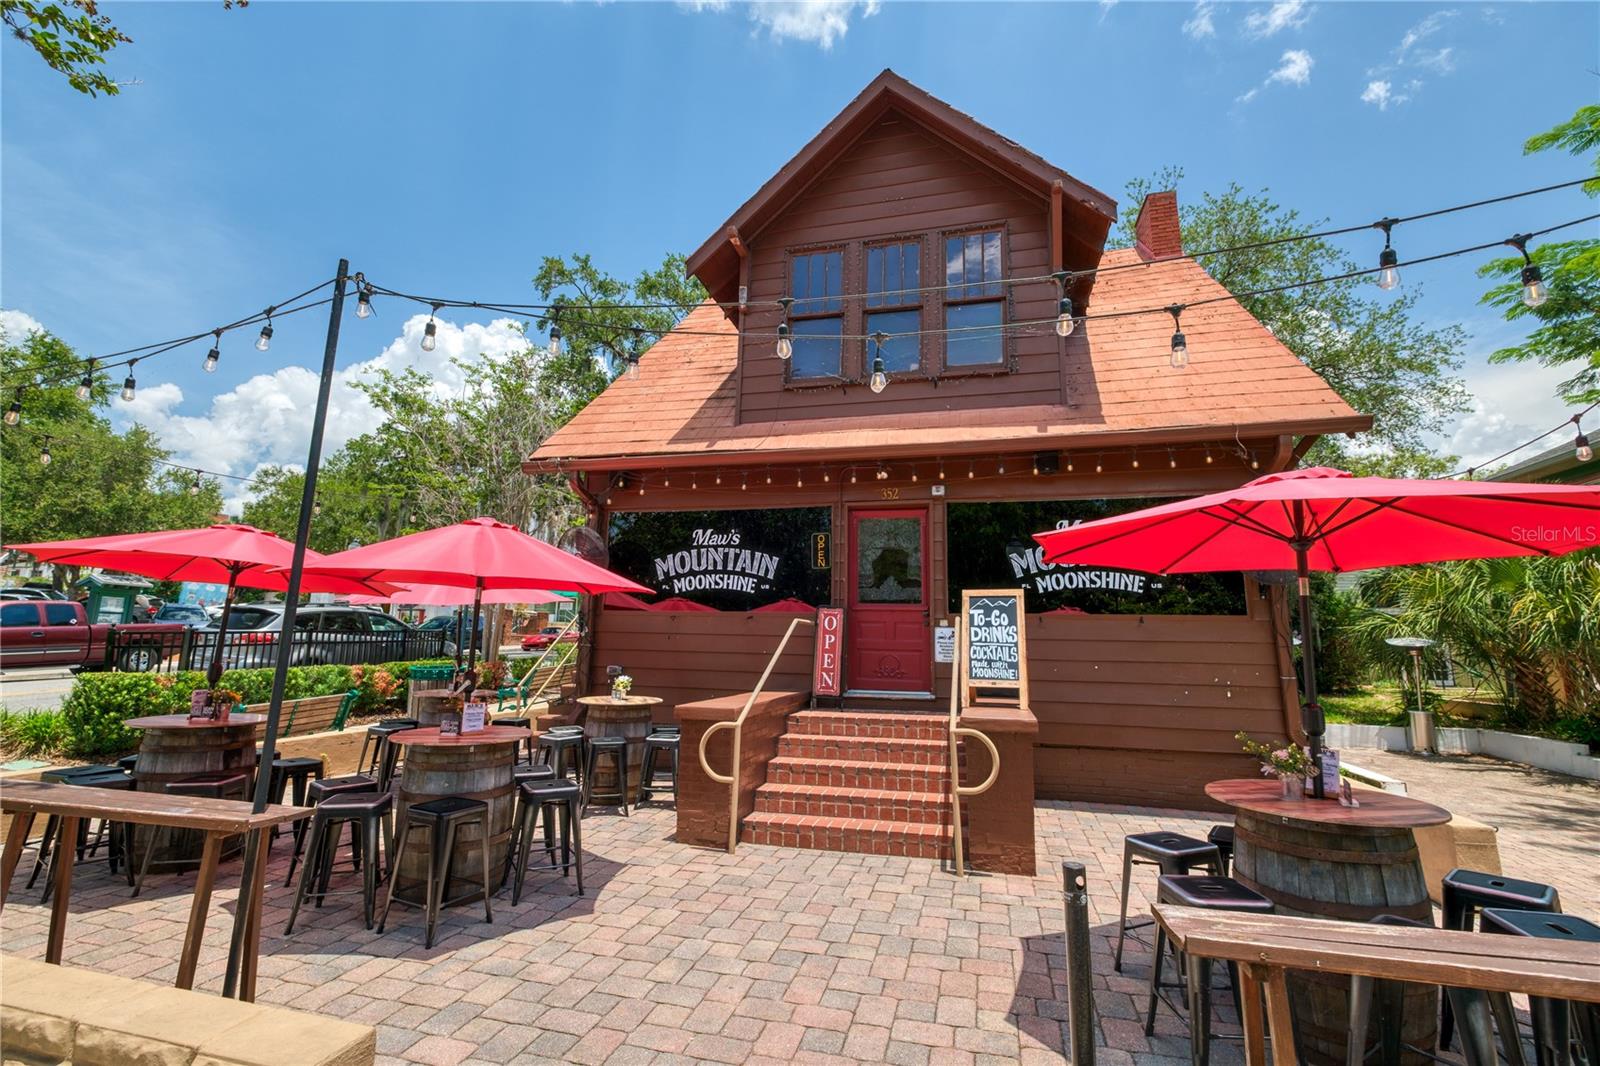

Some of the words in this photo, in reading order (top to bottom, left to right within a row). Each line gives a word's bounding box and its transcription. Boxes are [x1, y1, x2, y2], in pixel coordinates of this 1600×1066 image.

[881, 488, 899, 500] 352
[692, 529, 741, 546] Maw's
[817, 534, 826, 568] OPEN
[654, 547, 780, 580] MOUNTAIN
[673, 574, 758, 594] MOONSHINE
[1035, 571, 1146, 594] MOONSHINE
[970, 609, 1009, 626] To-Go
[970, 625, 1018, 643] DRINKS
[821, 616, 837, 687] OPEN
[970, 645, 1018, 662] COCKTAILS
[991, 660, 1009, 669] with
[972, 668, 1018, 679] MOONSHINE!
